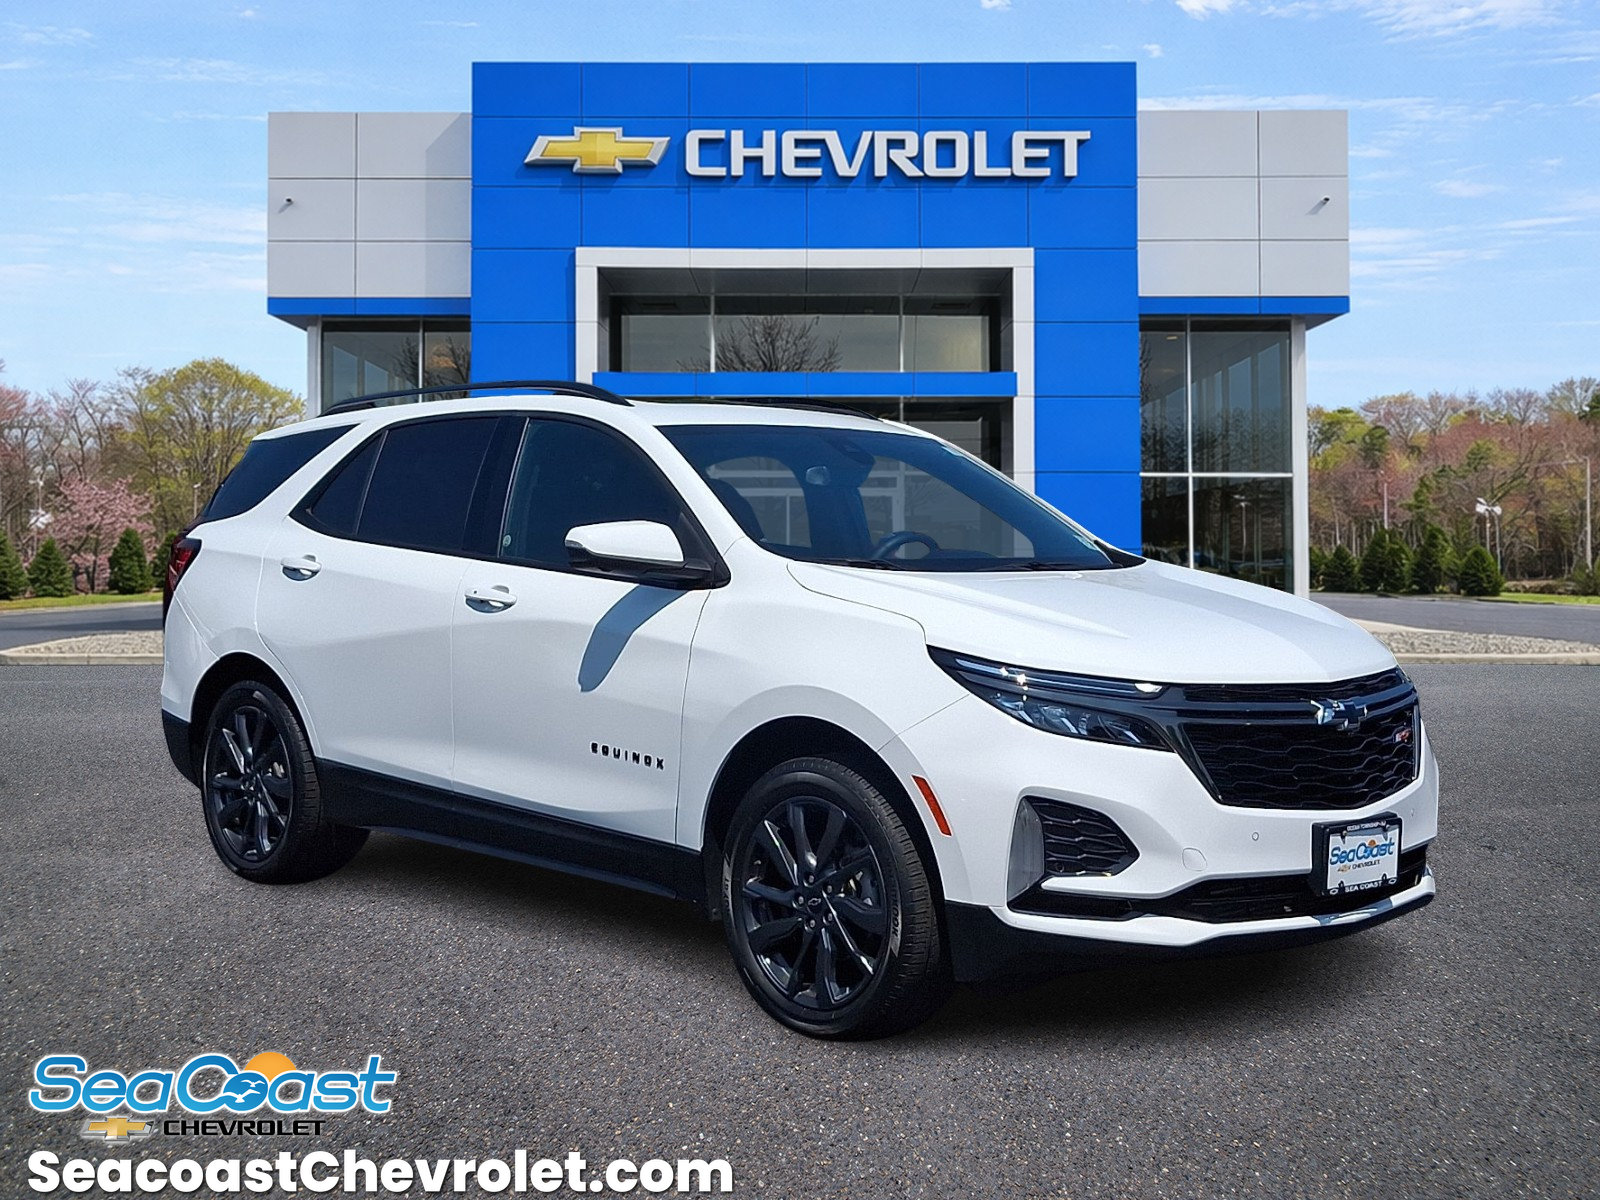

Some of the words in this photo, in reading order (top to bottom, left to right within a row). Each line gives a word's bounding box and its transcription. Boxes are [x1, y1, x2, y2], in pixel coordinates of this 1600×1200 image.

[685, 129, 1091, 178] CHEVROLET
[591, 742, 664, 770] EQUINOX
[1352, 860, 1380, 870] CHEVROLET
[1345, 883, 1359, 893] SEA
[1360, 880, 1383, 890] COAST
